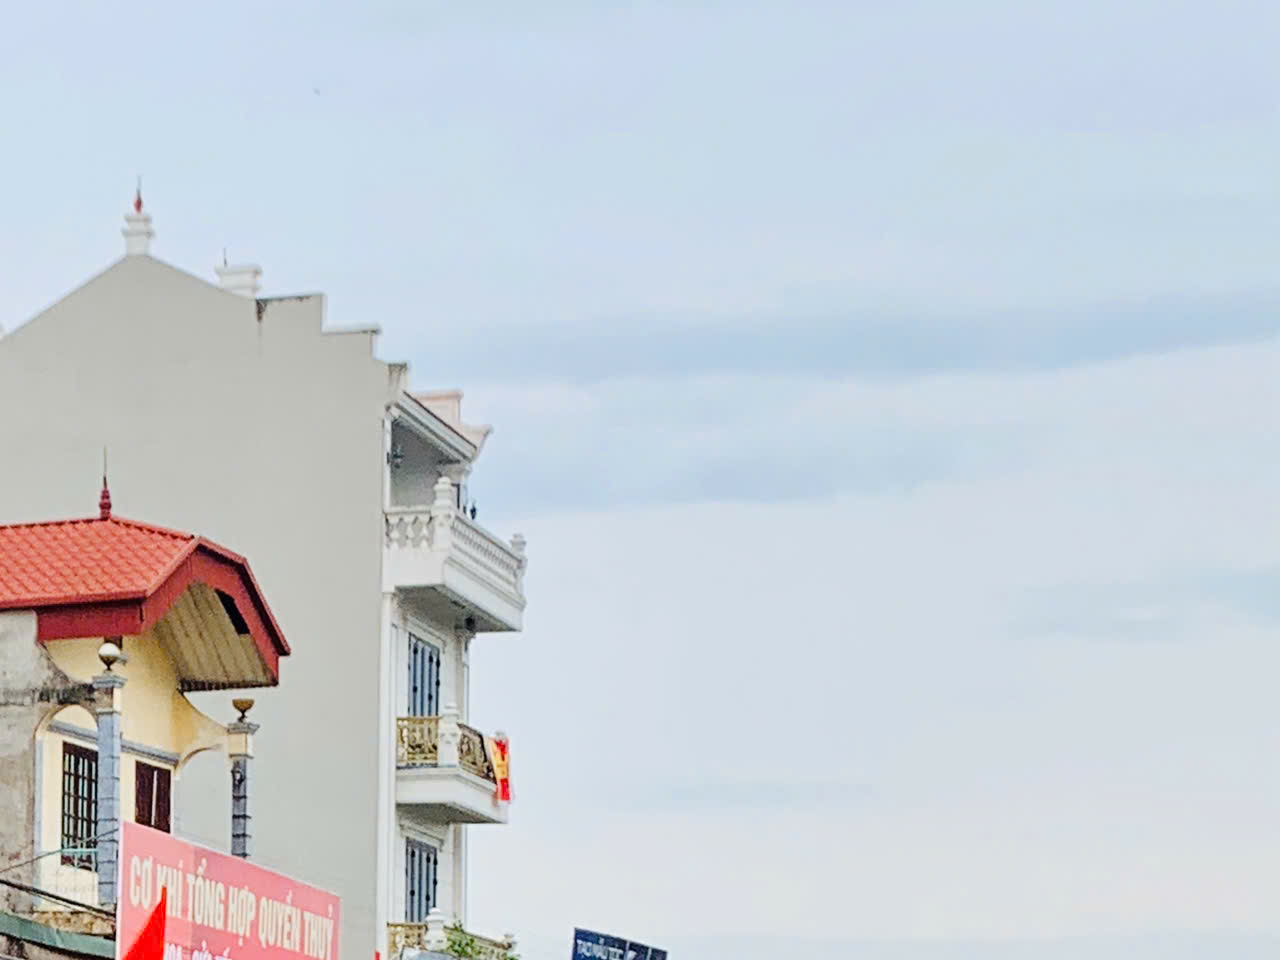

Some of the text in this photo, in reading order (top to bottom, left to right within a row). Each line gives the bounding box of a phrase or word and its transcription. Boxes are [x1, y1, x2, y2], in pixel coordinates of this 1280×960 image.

[129, 855, 153, 909] CƠ
[186, 858, 225, 929] TỔNG
[227, 884, 256, 946] HỢP
